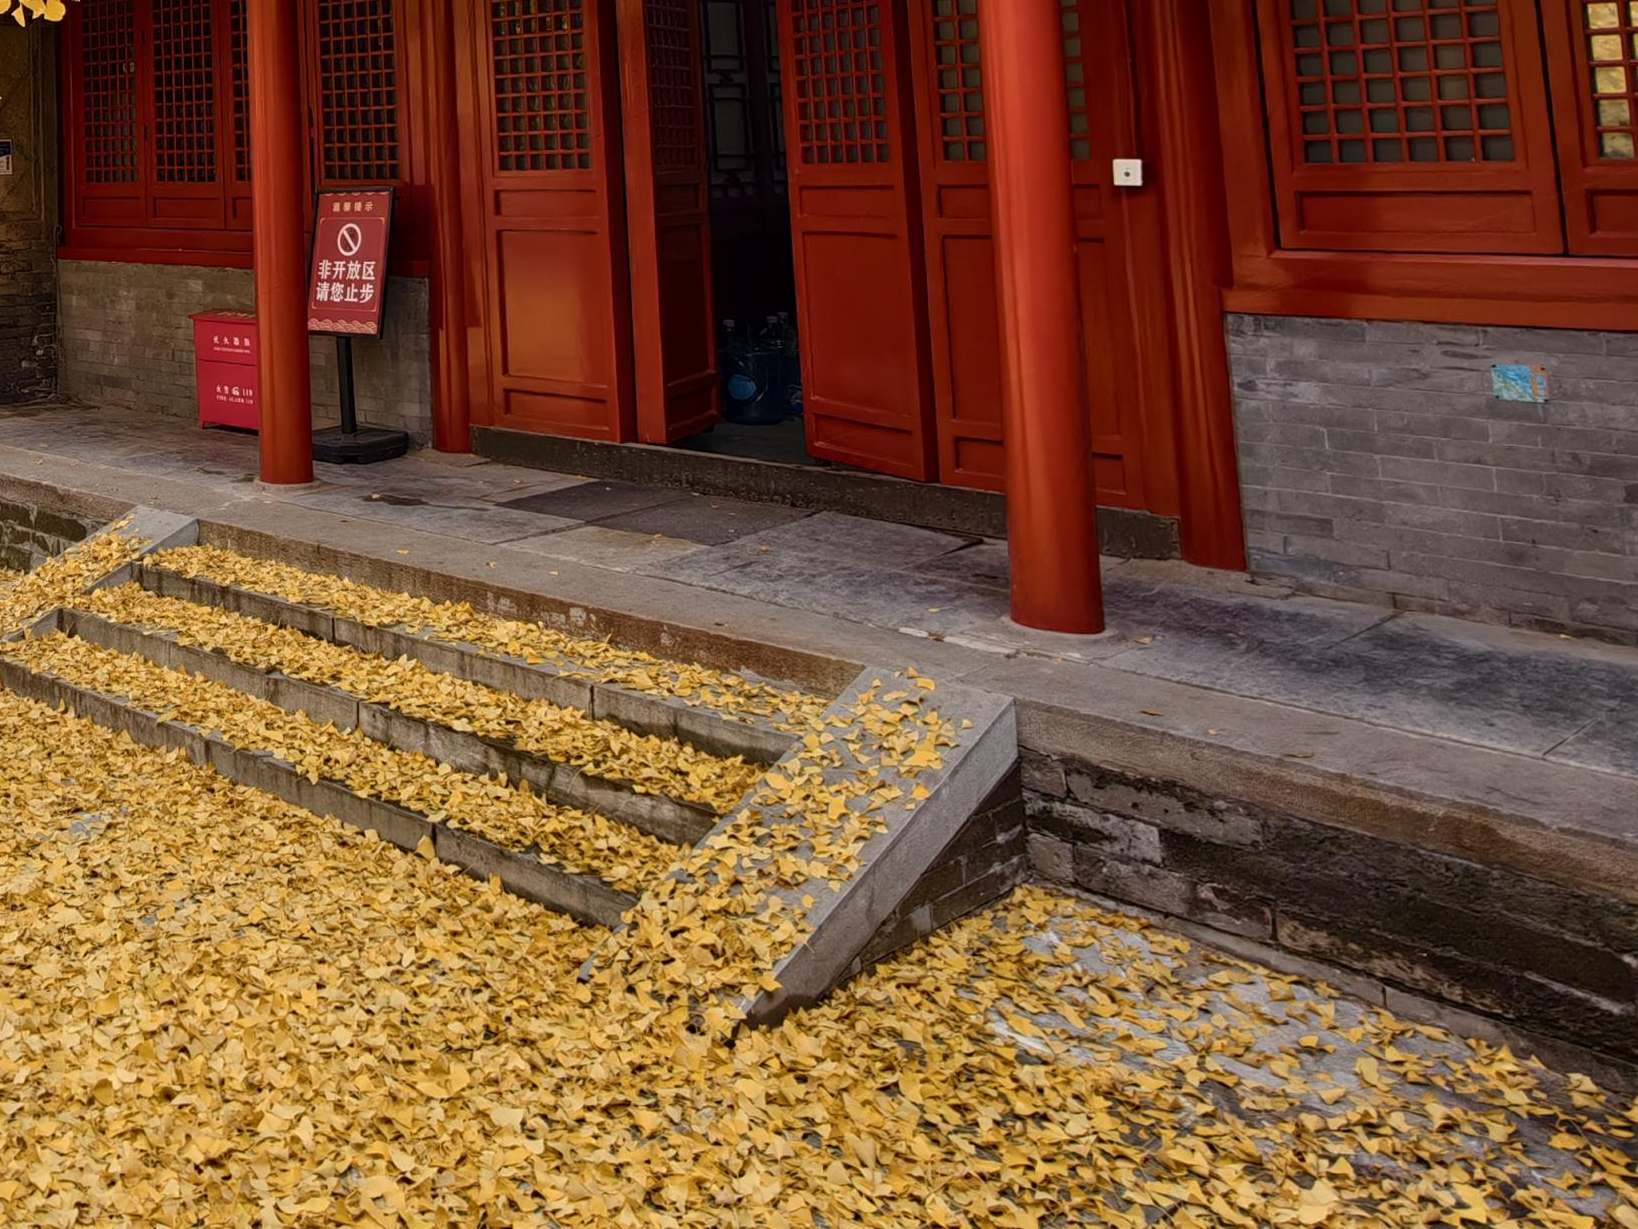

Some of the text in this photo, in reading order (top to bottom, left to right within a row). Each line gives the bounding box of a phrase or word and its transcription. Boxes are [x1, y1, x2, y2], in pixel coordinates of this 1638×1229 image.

[317, 259, 377, 281] 非开放区
[315, 281, 375, 304] 请您止步
